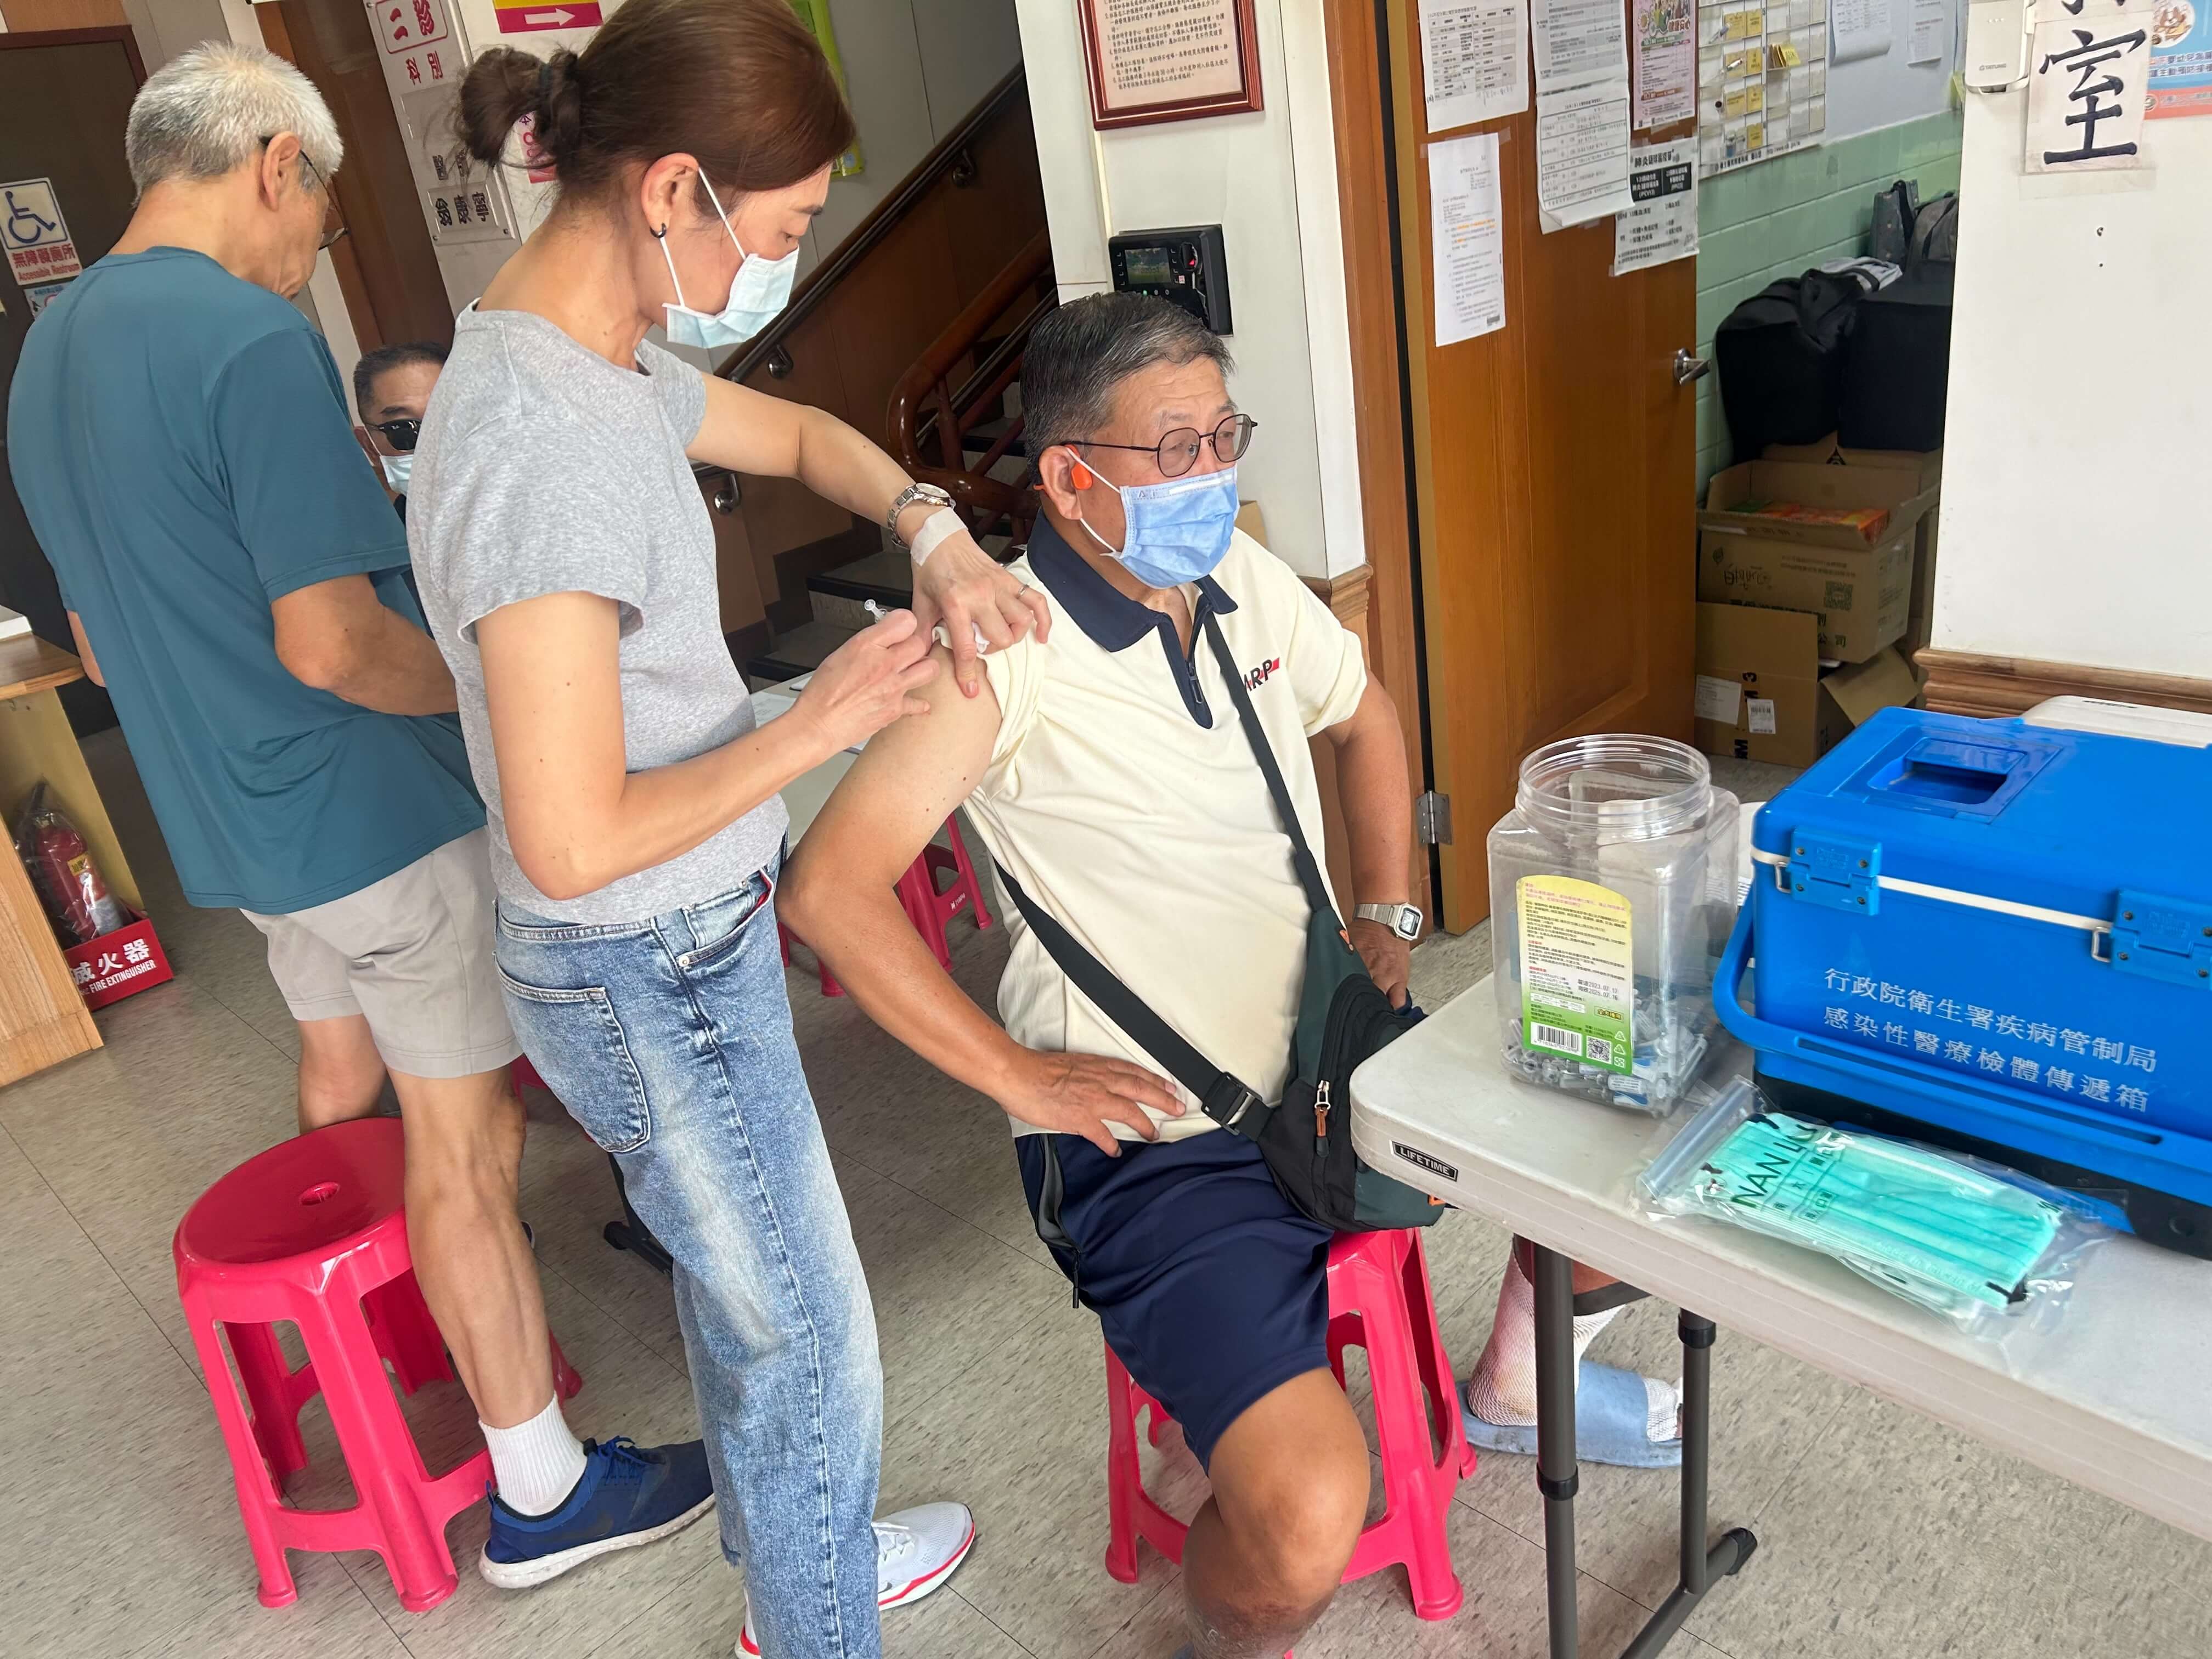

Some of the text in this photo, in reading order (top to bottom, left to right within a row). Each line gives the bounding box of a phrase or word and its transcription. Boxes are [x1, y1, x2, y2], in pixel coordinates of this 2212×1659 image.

[2039, 0, 2147, 165] 室
[12, 243, 76, 268] 無障礙廁所
[18, 263, 80, 281] Accessible Restroom
[71, 938, 150, 985] 滅火器
[89, 959, 157, 993] FIRE EXTINGUISHER
[1824, 967, 2158, 1073] 行政院衛生署疾病管制局
[1823, 1006, 2149, 1113] 感染性醫療檢體傳遞箱
[1400, 1147, 1449, 1175] LIFETIME
[1731, 1153, 1791, 1209] NAN
